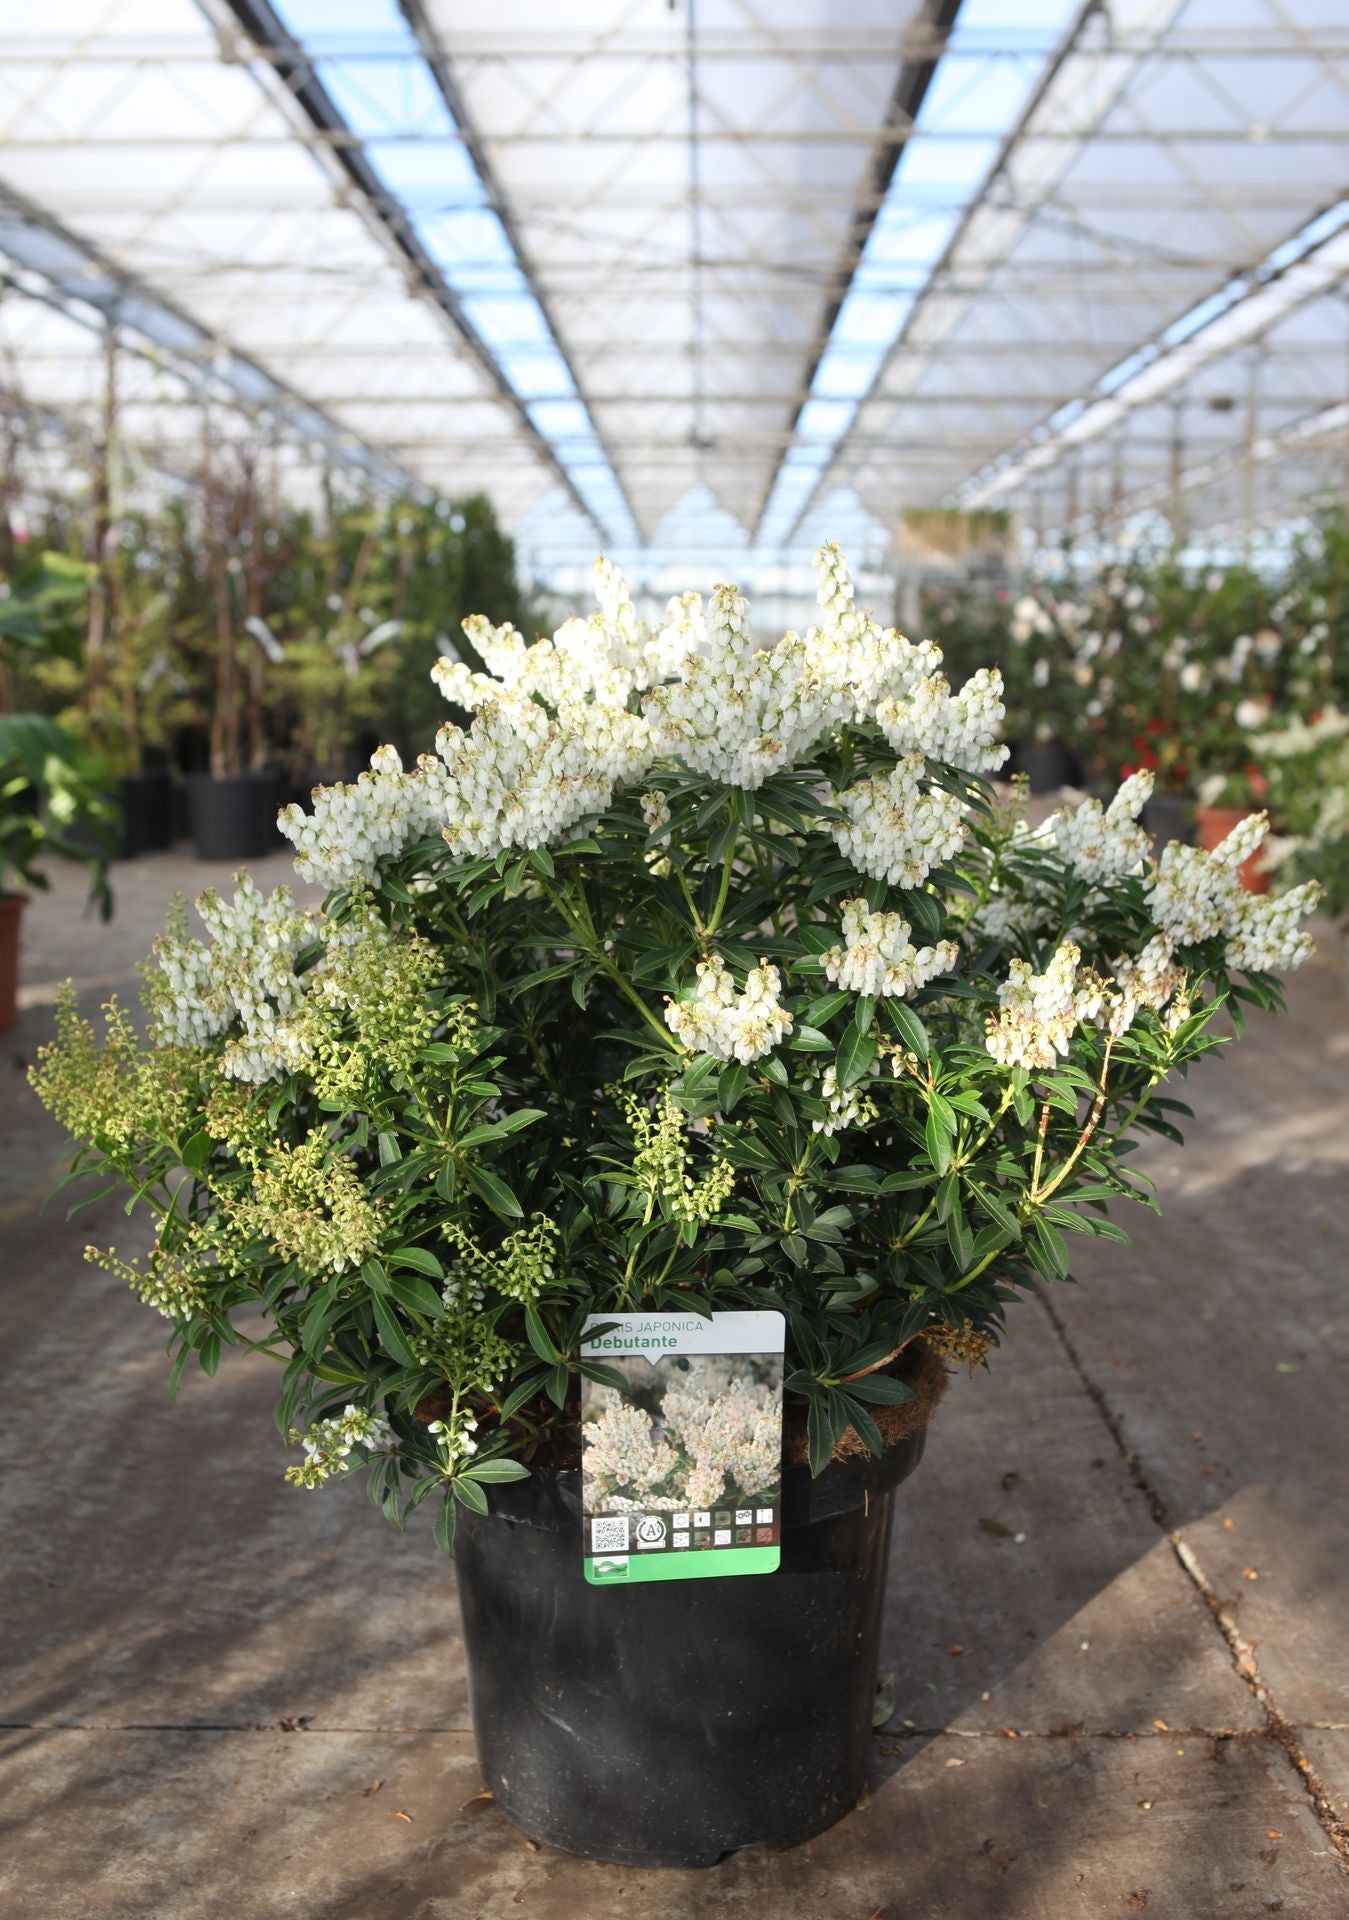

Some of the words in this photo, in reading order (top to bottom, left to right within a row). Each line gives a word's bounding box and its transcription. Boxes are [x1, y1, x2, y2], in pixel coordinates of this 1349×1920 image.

[637, 1321, 704, 1333] JAPONICA
[591, 1336, 678, 1349] Debutante
[646, 1524, 656, 1536] A
